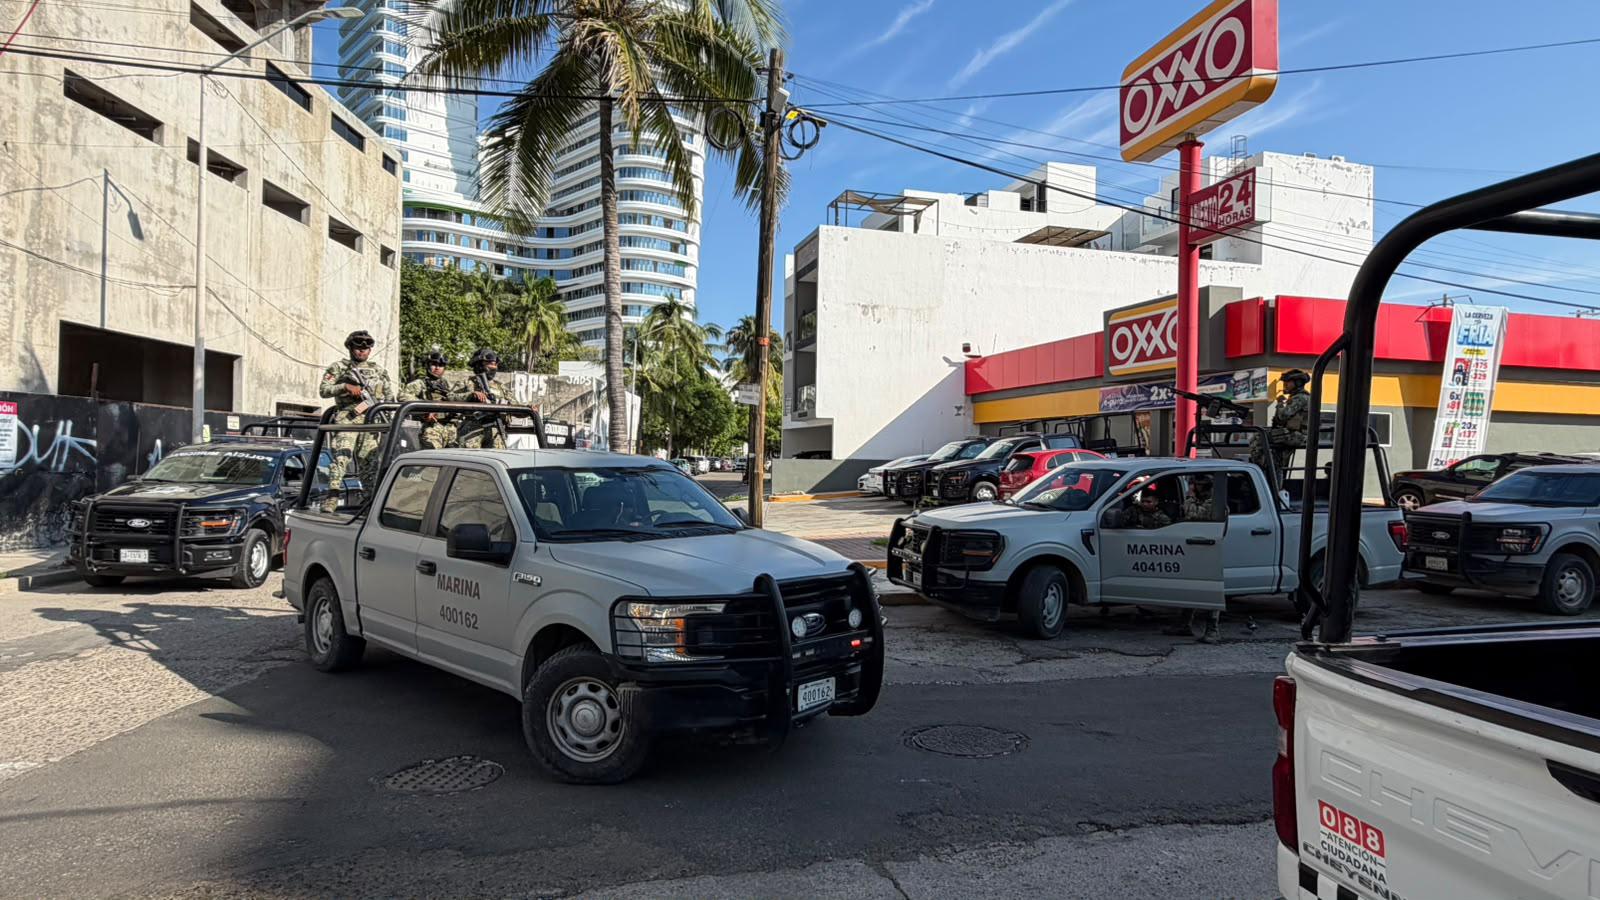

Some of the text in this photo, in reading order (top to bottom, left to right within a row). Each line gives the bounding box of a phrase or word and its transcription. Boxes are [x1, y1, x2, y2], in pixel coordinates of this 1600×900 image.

[1124, 17, 1245, 133] OXXO
[1220, 173, 1251, 214] 24
[1218, 207, 1251, 228] HORAS
[1127, 544, 1185, 556] MARINA
[1132, 562, 1180, 573] 404169
[437, 574, 481, 600] MARINA
[440, 604, 479, 630] 400162
[802, 686, 832, 703] 400162
[1321, 750, 1600, 900] CHEV
[1322, 806, 1381, 852] 088
[1321, 840, 1387, 885] CIUDADANA
